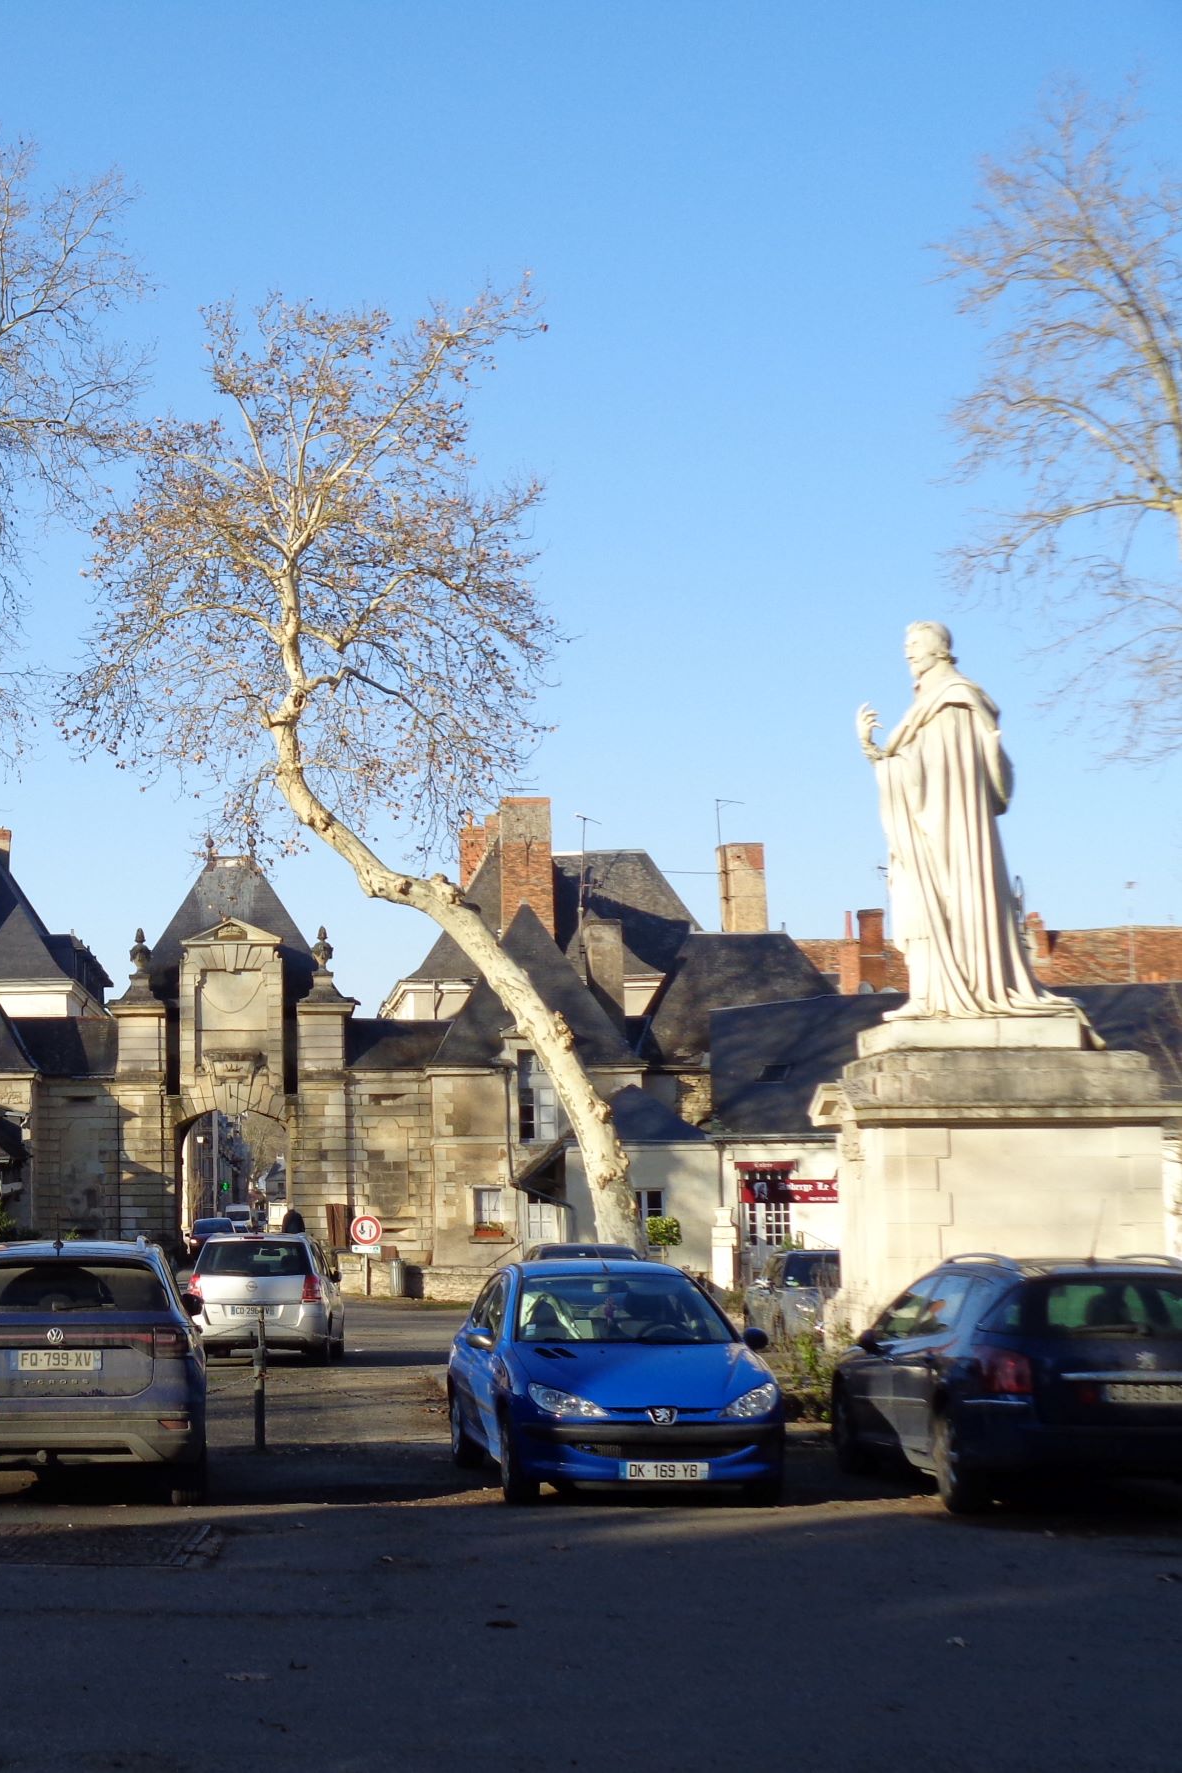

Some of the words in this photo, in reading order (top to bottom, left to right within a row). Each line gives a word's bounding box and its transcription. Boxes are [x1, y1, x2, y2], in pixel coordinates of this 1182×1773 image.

[778, 1182, 814, 1193] Auberge
[816, 1181, 829, 1191] Le
[21, 1352, 92, 1367] FQ-799-XV
[629, 1463, 698, 1478] DK-169-YB
